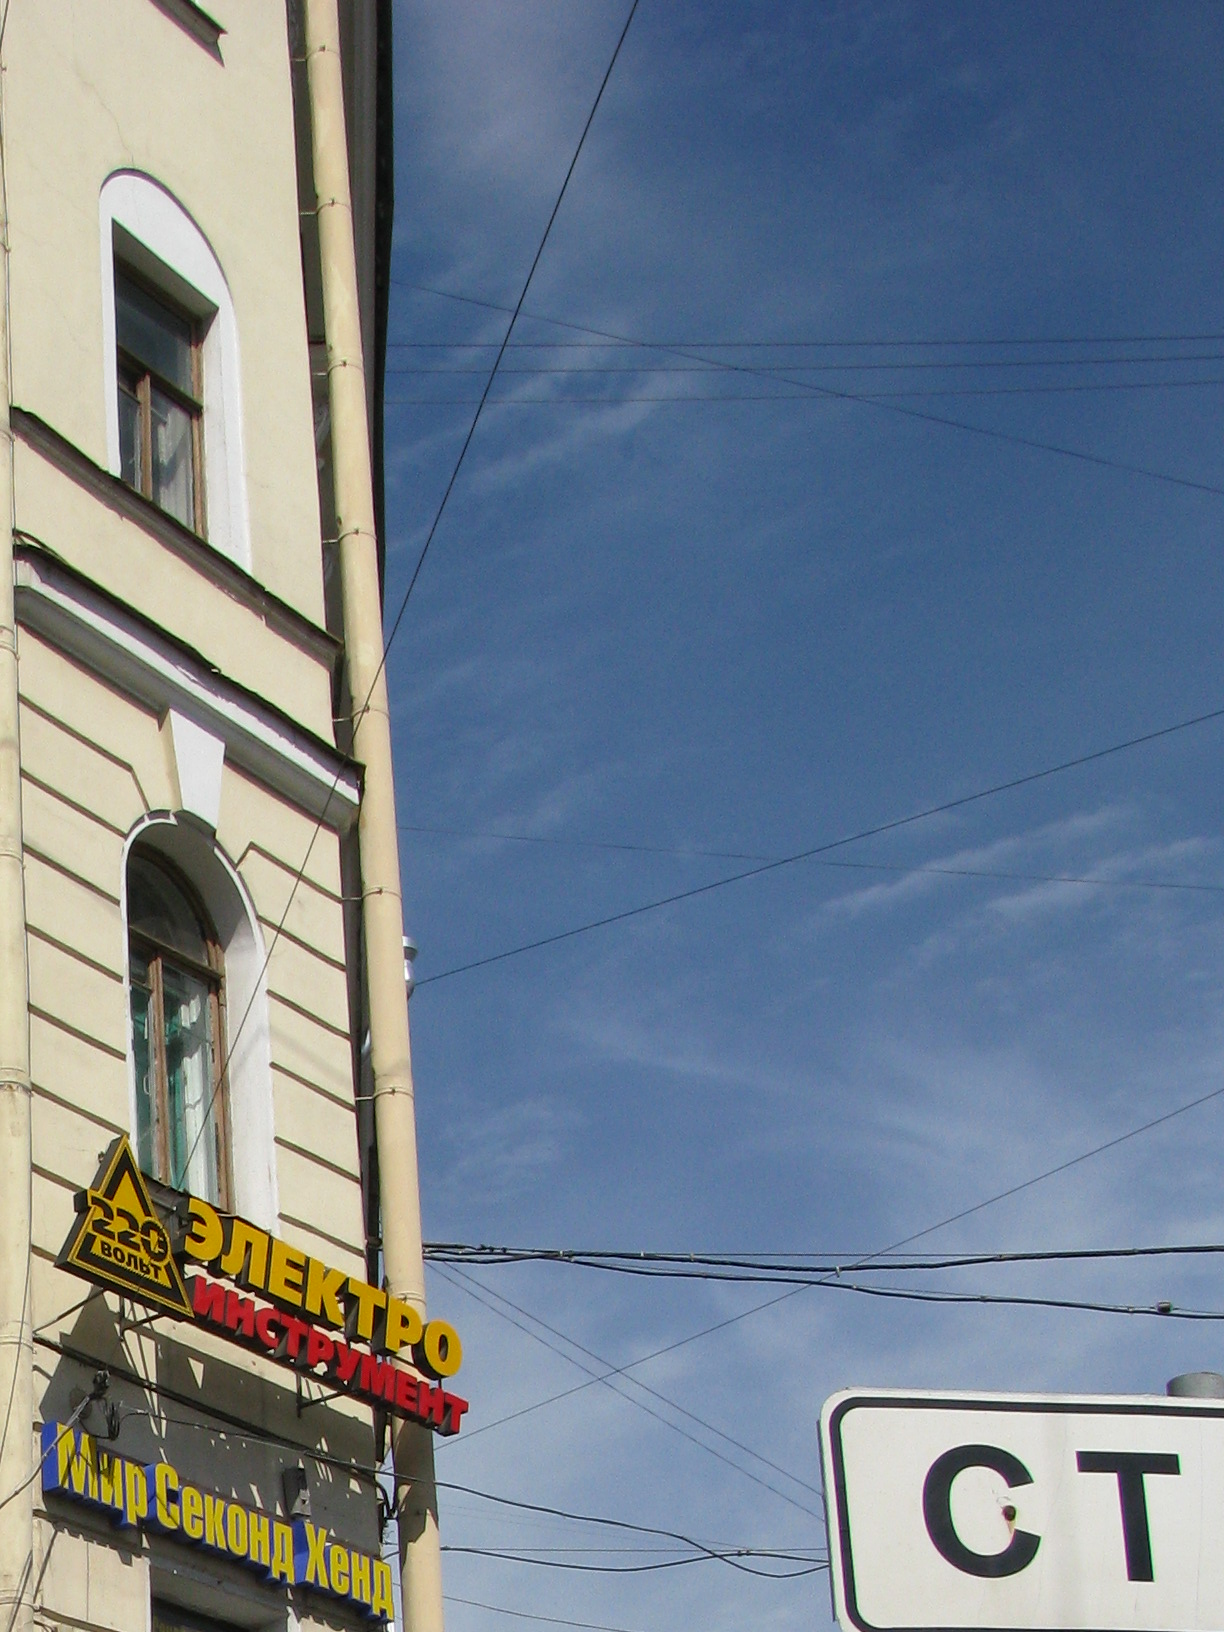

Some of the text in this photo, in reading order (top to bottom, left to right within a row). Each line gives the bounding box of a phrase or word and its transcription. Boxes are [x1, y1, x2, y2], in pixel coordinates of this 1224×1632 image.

[87, 1196, 169, 1262] 220
[100, 1240, 163, 1281] ВОЛЬТ
[182, 1198, 463, 1379] ЭЛЕКТРО
[194, 1274, 469, 1434] ИНСТРУМЕНТ
[54, 1422, 395, 1623] Мир Секонд Хенд
[923, 1443, 1182, 1583] СТ
